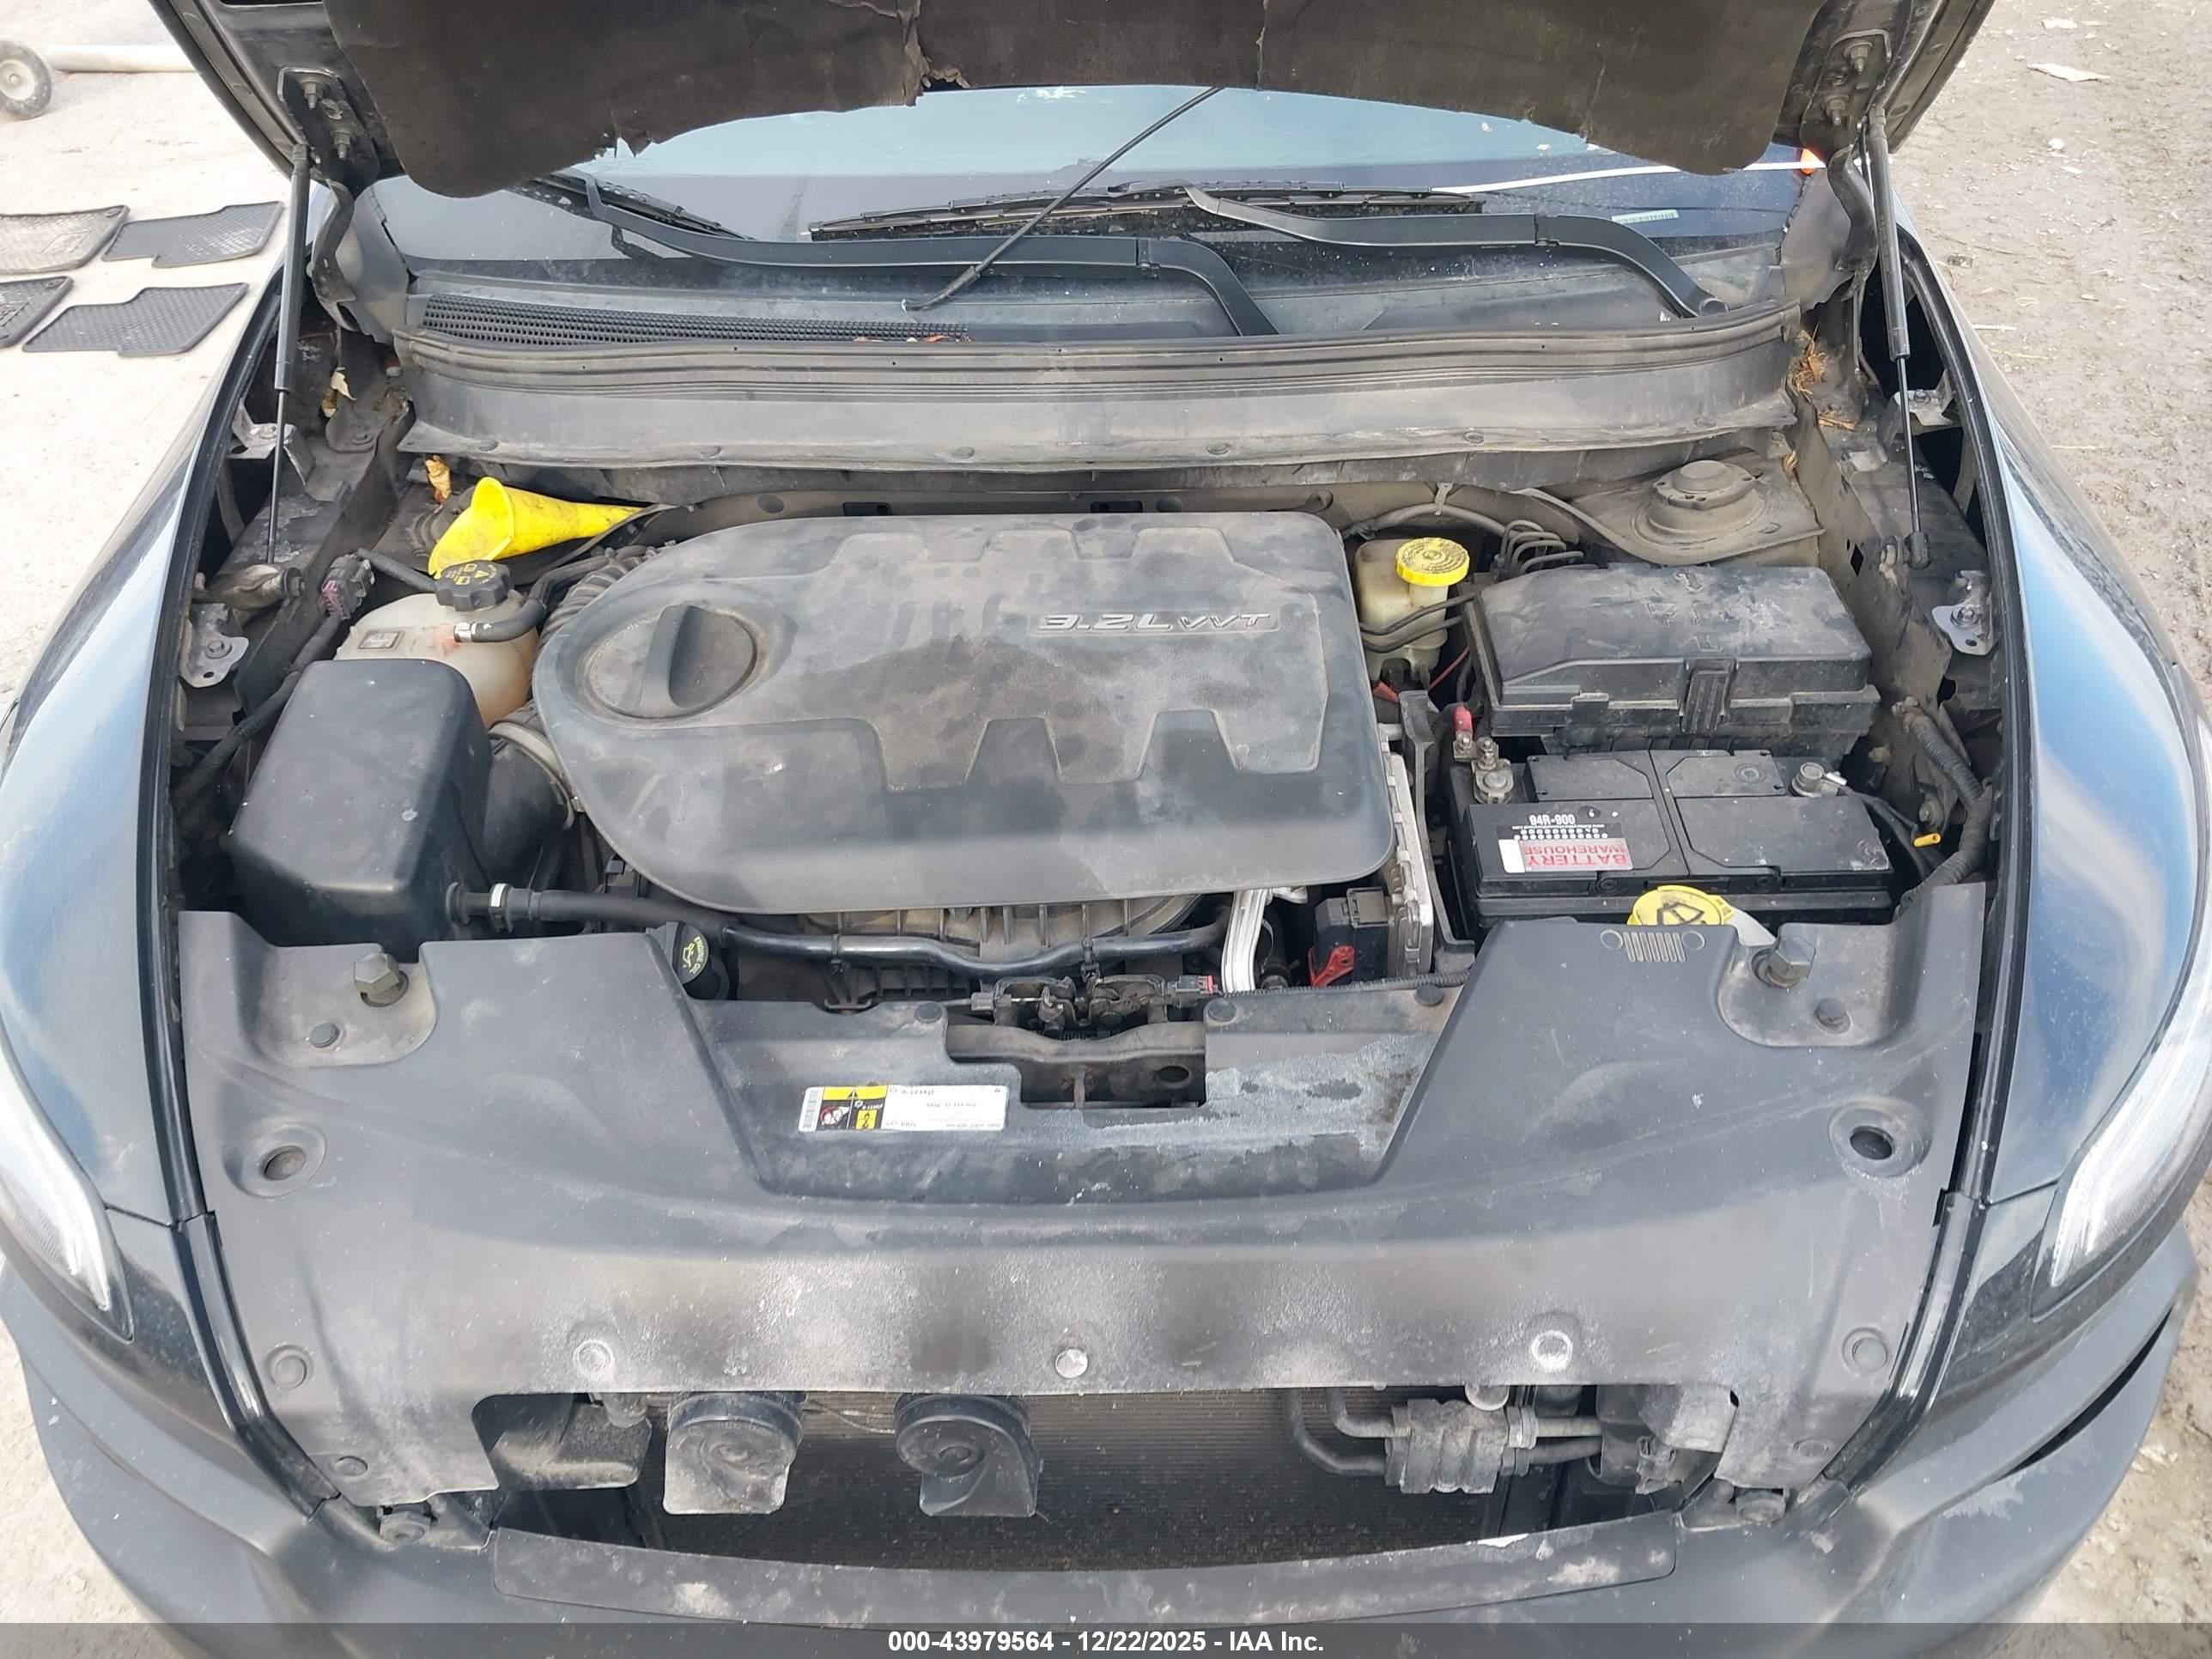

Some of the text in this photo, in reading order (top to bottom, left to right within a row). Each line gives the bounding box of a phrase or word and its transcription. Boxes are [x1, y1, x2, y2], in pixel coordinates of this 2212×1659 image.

[1038, 612, 1271, 632] 3.2L VVT
[1528, 814, 1576, 825] 94R-900
[1523, 845, 1625, 854] WAREHOUSE
[1528, 854, 1627, 866] BATTERY
